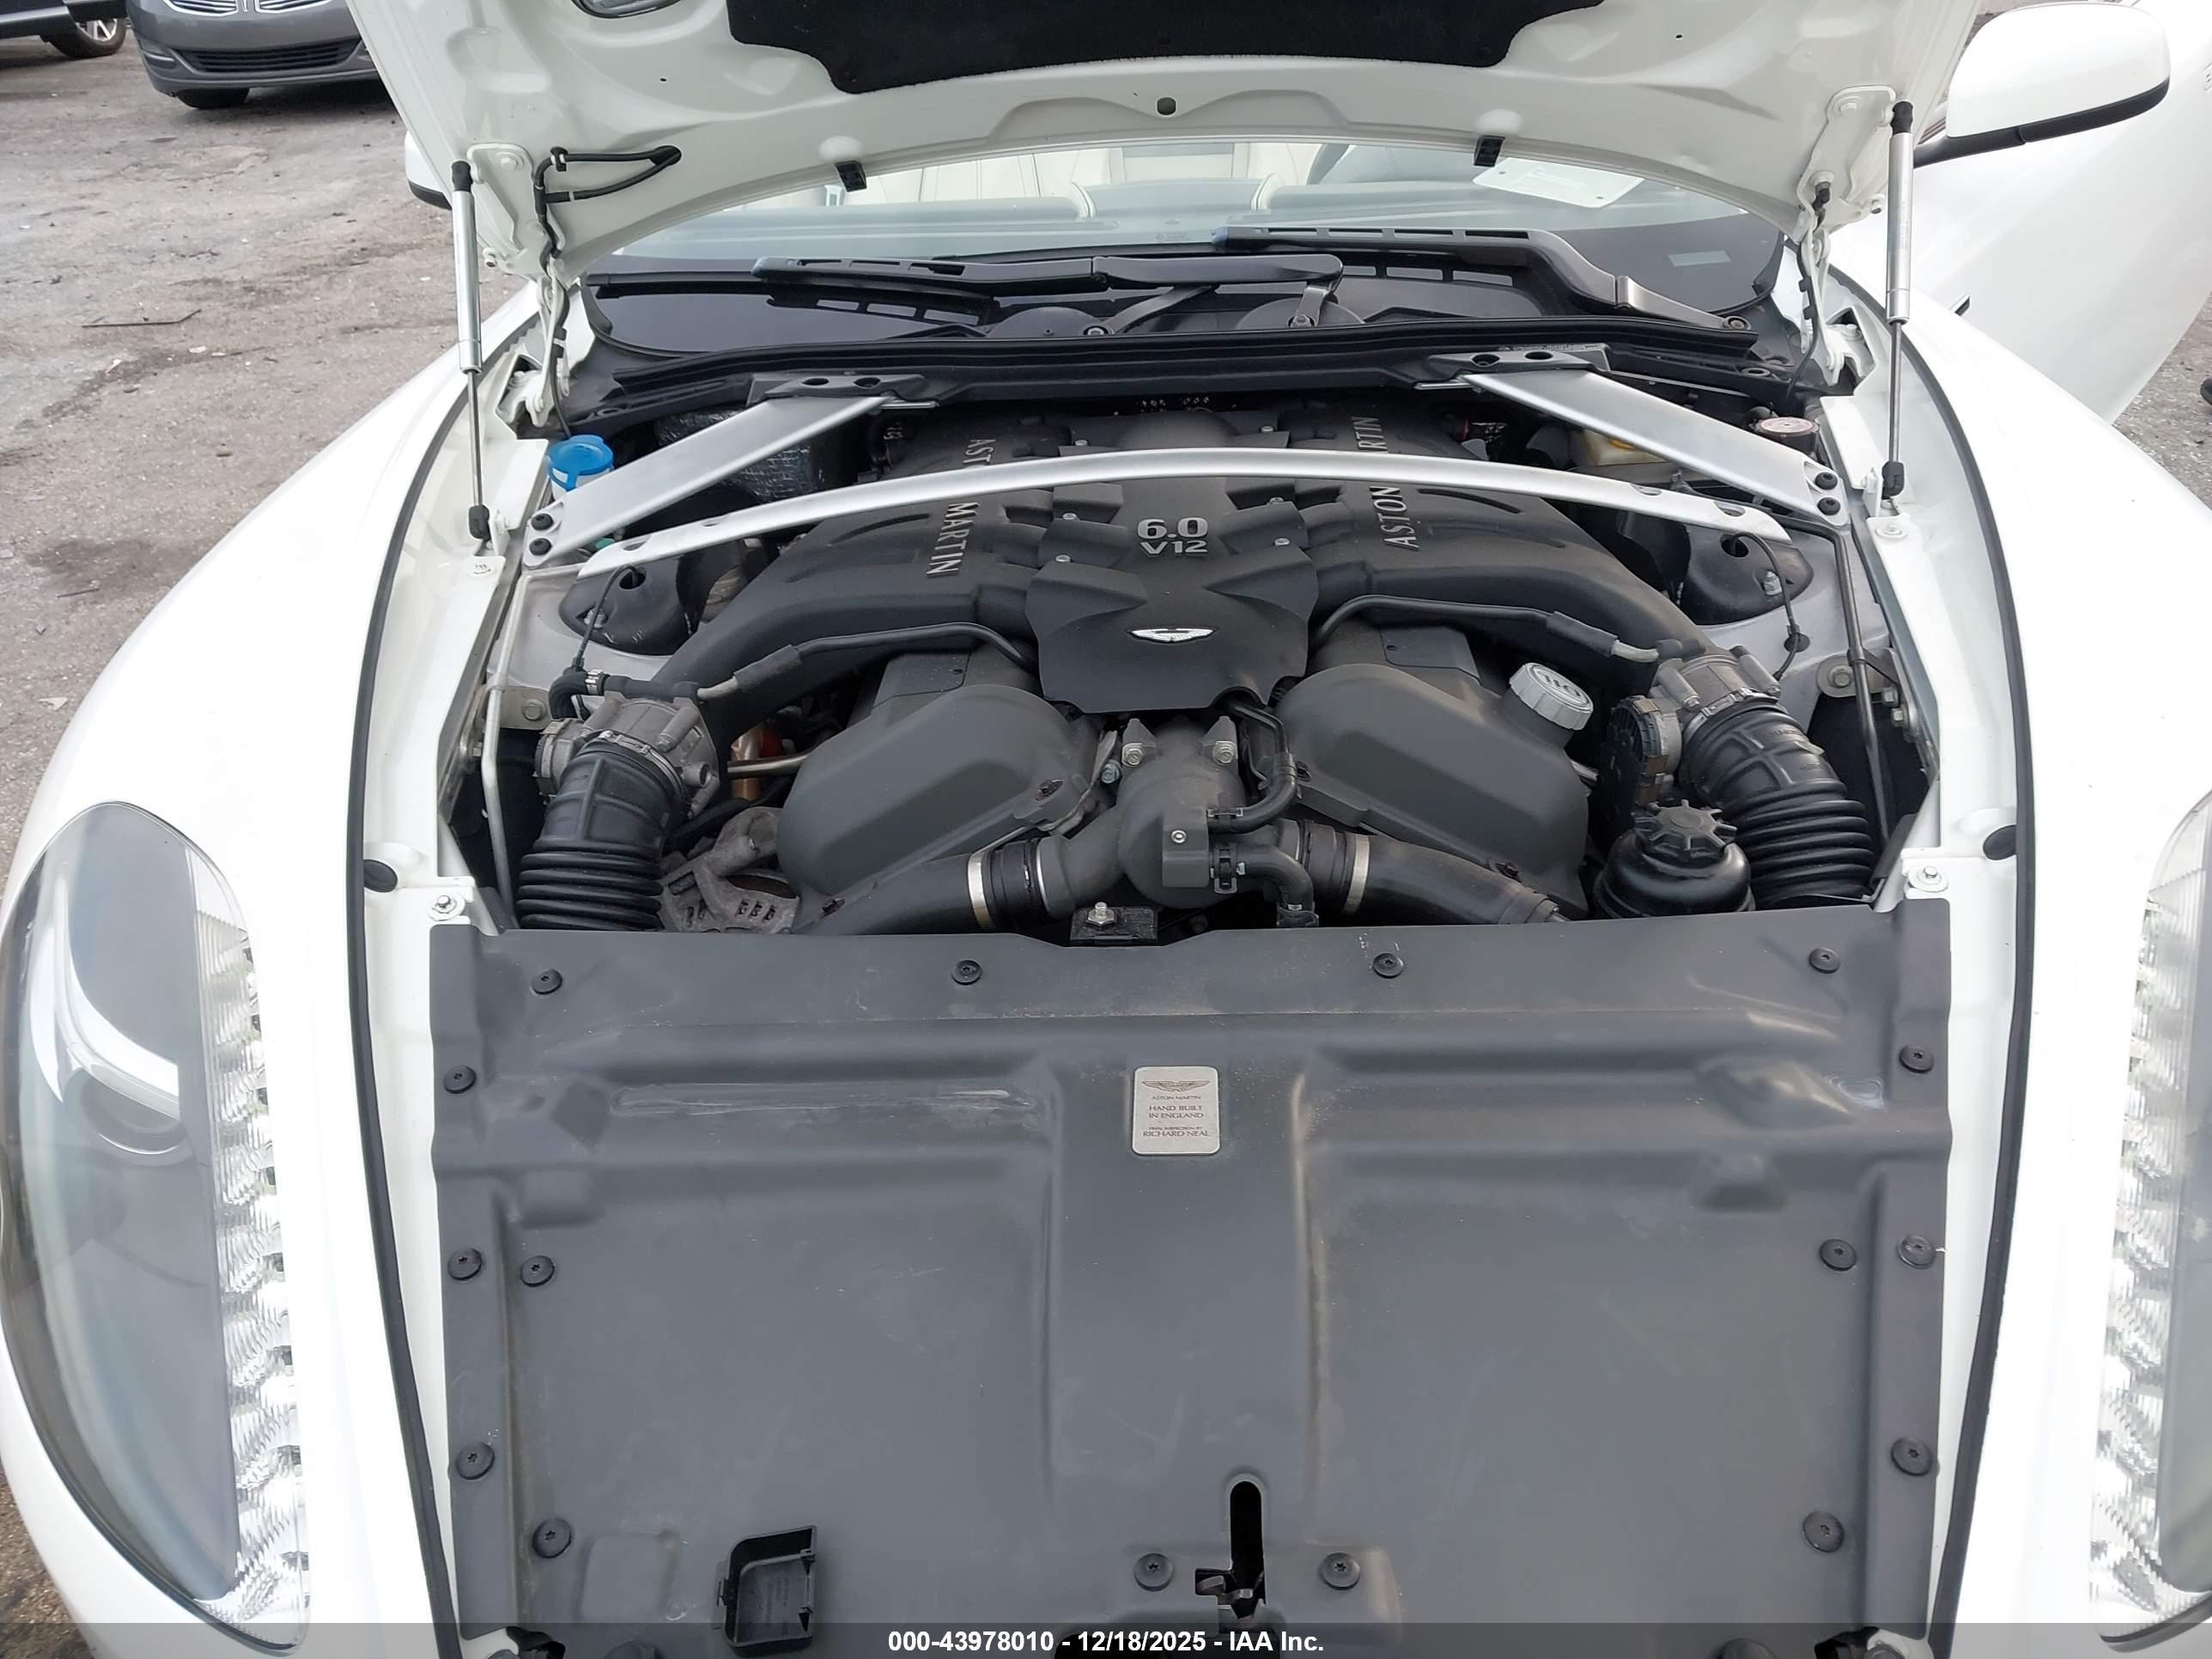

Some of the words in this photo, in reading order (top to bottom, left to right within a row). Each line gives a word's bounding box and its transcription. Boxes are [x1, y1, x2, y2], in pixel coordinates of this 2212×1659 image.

[1351, 416, 1389, 453] RTIN
[962, 439, 997, 466] AST
[1137, 517, 1208, 540] 6.0
[1369, 485, 1419, 550] ASTON
[926, 501, 980, 575] MARTIN
[1139, 540, 1208, 556] V12
[1536, 670, 1582, 698] OIL
